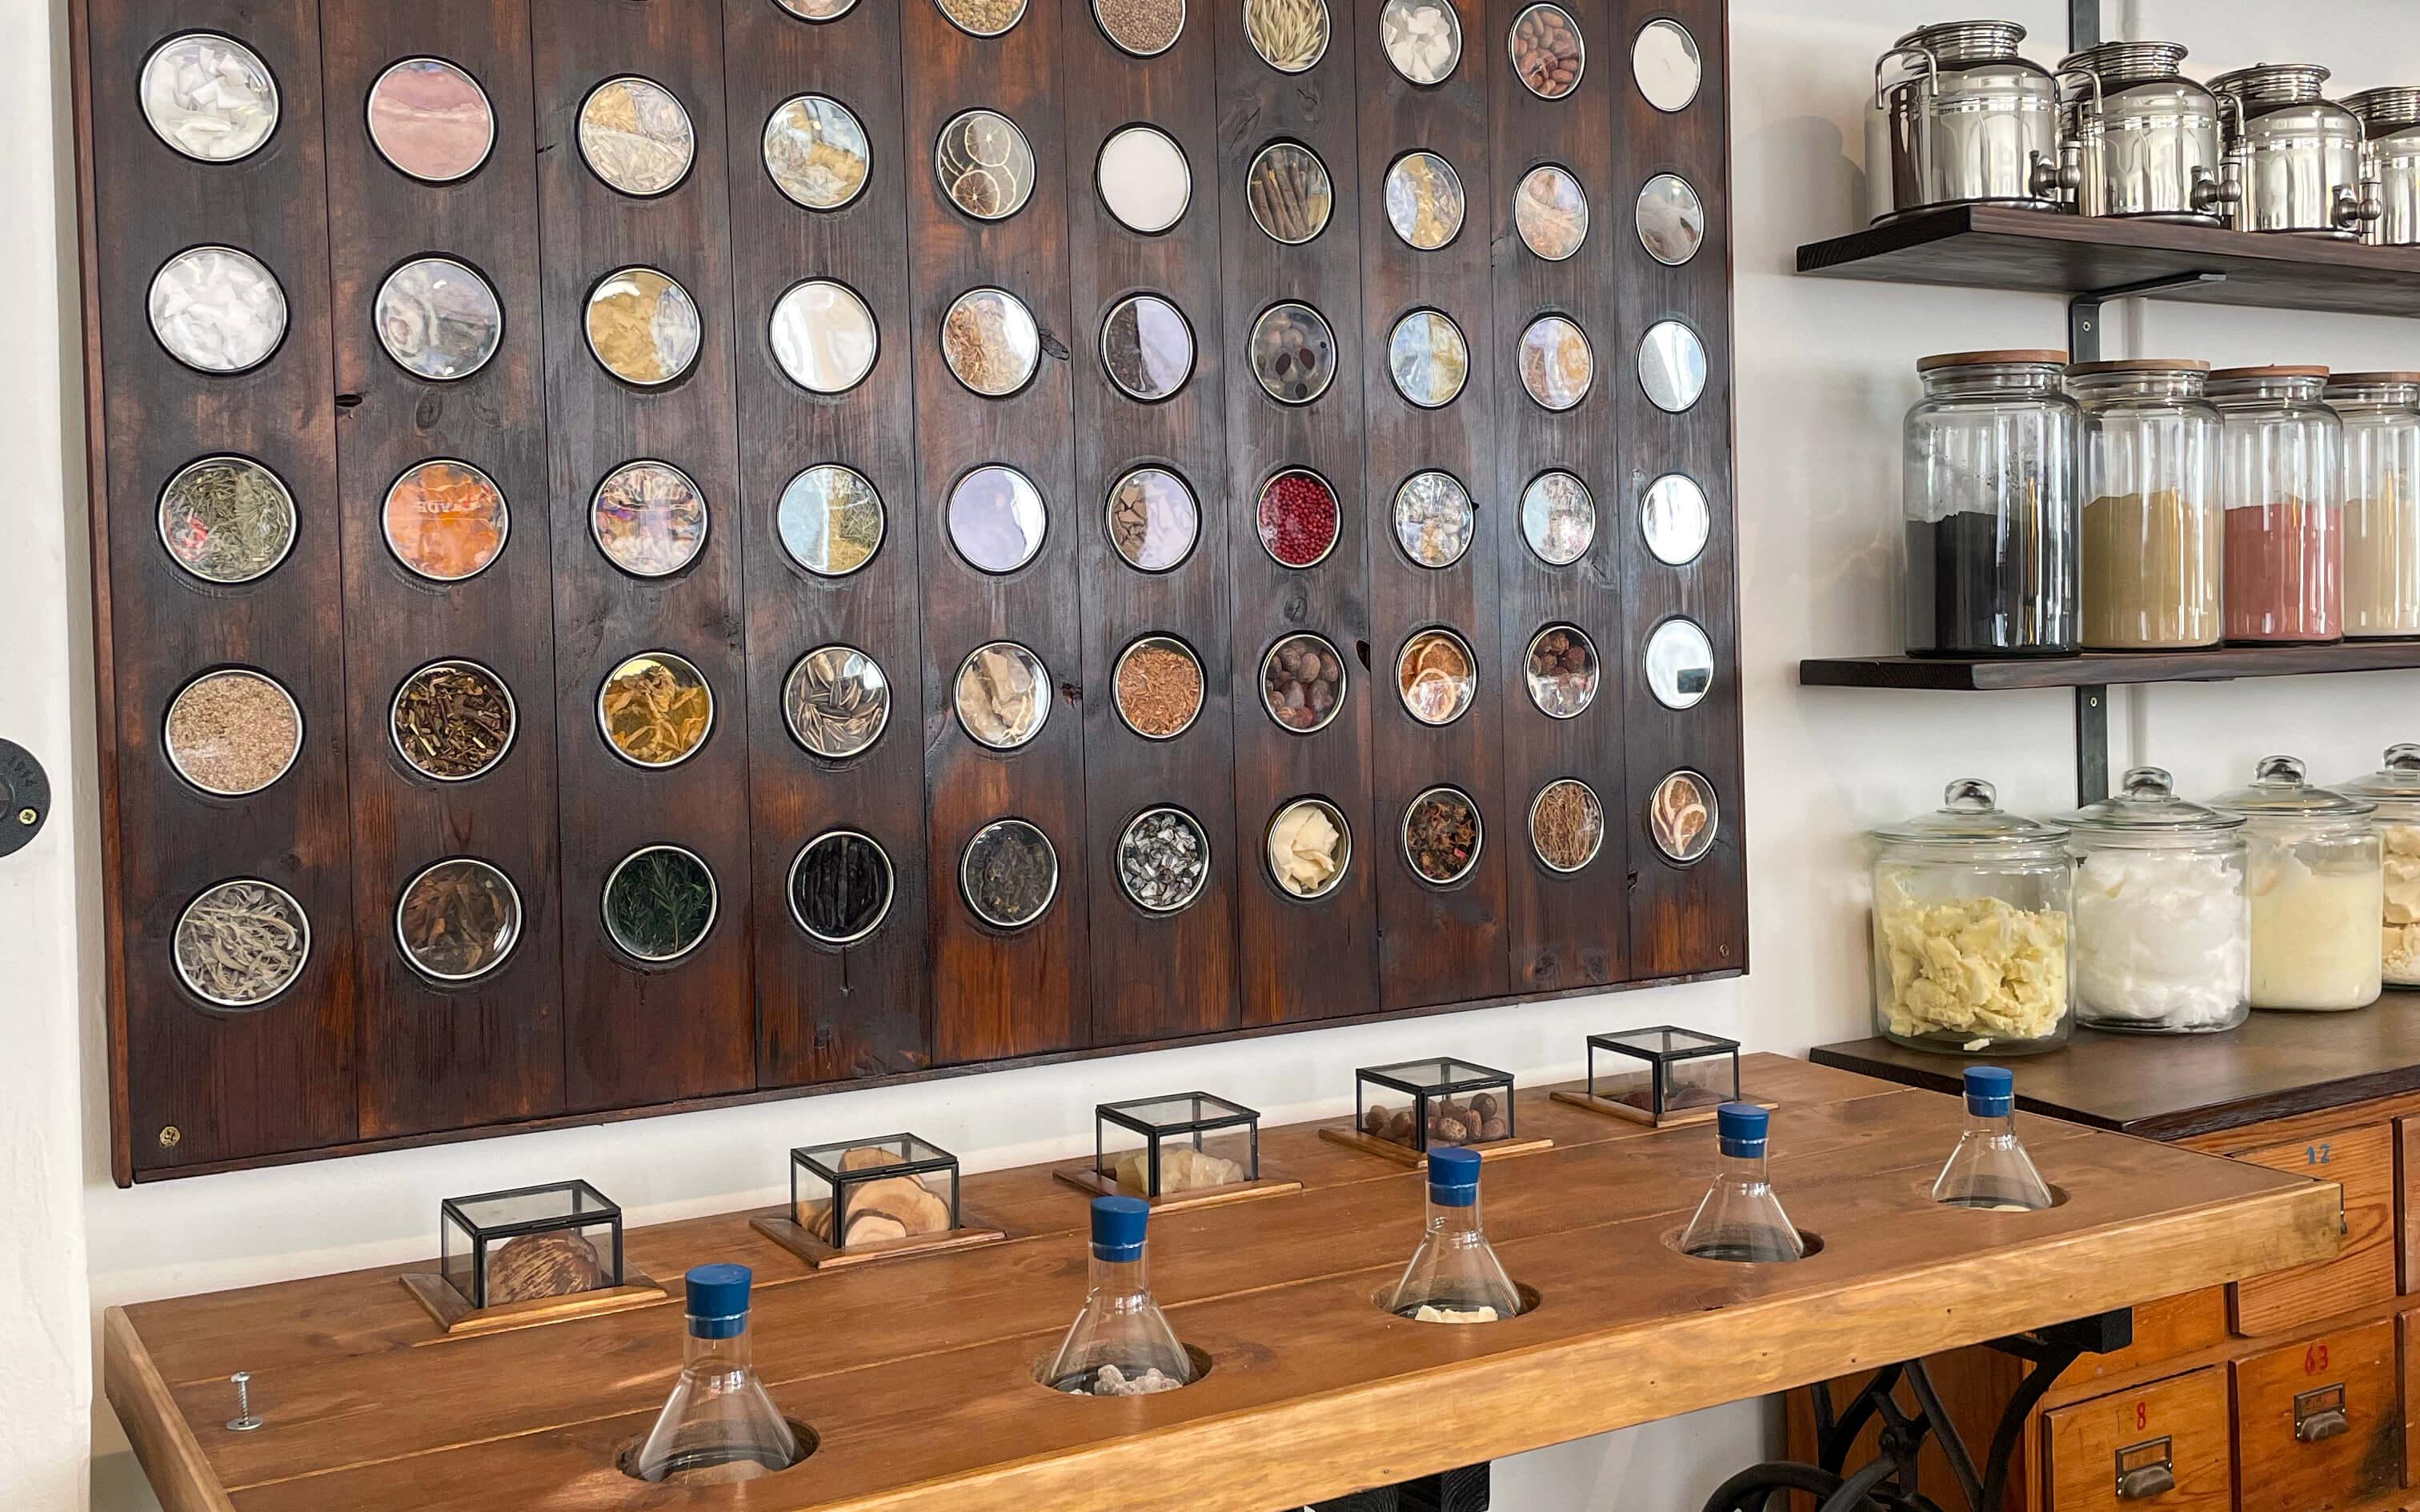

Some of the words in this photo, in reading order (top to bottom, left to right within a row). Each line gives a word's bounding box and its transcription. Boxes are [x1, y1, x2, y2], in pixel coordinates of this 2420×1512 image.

[2305, 1143, 2330, 1165] 12
[2305, 1344, 2329, 1376] 63
[2137, 1401, 2146, 1431] 8
